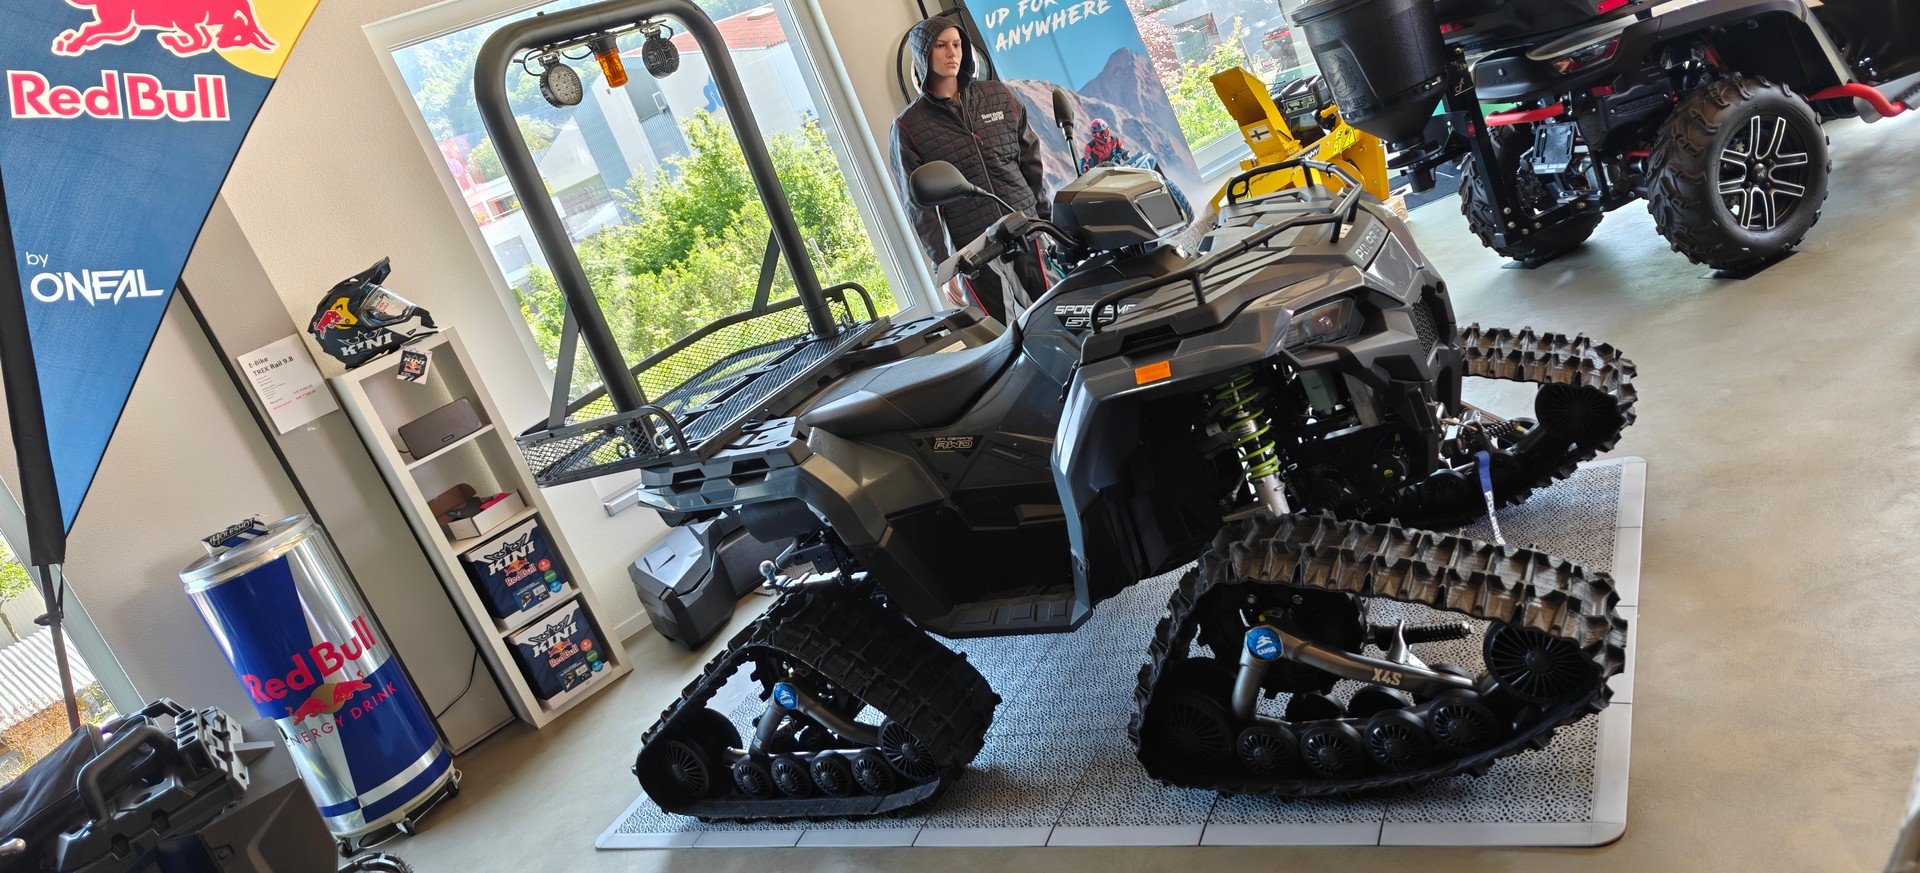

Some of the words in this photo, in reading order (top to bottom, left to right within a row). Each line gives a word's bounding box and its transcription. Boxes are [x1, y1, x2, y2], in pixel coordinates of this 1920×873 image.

[985, 7, 1010, 29] UP
[995, 0, 1113, 53] ANYWHERE
[7, 69, 123, 119] Red
[124, 73, 230, 121] Bull
[1354, 223, 1383, 261] POLARIS
[25, 252, 49, 268] by
[30, 268, 164, 306] O'NEAL
[340, 332, 393, 356] KINI
[248, 357, 268, 369] E-Bike
[252, 365, 270, 377] TREK
[269, 360, 283, 370] Rail
[282, 355, 294, 365] 9.8
[934, 440, 973, 450] AWD
[1484, 490, 1506, 545] POLARIS
[209, 518, 254, 546] HOLESHOT
[488, 540, 536, 576] KINI
[504, 570, 523, 587] Red
[519, 562, 537, 579] Bull
[532, 621, 578, 658] KINI
[241, 652, 316, 704] Red
[308, 614, 377, 678] Bull
[548, 652, 566, 668] Red
[562, 643, 580, 661] Bull
[1371, 667, 1403, 687] X4S
[287, 715, 344, 748] NERGY
[350, 681, 397, 720] DRINK
